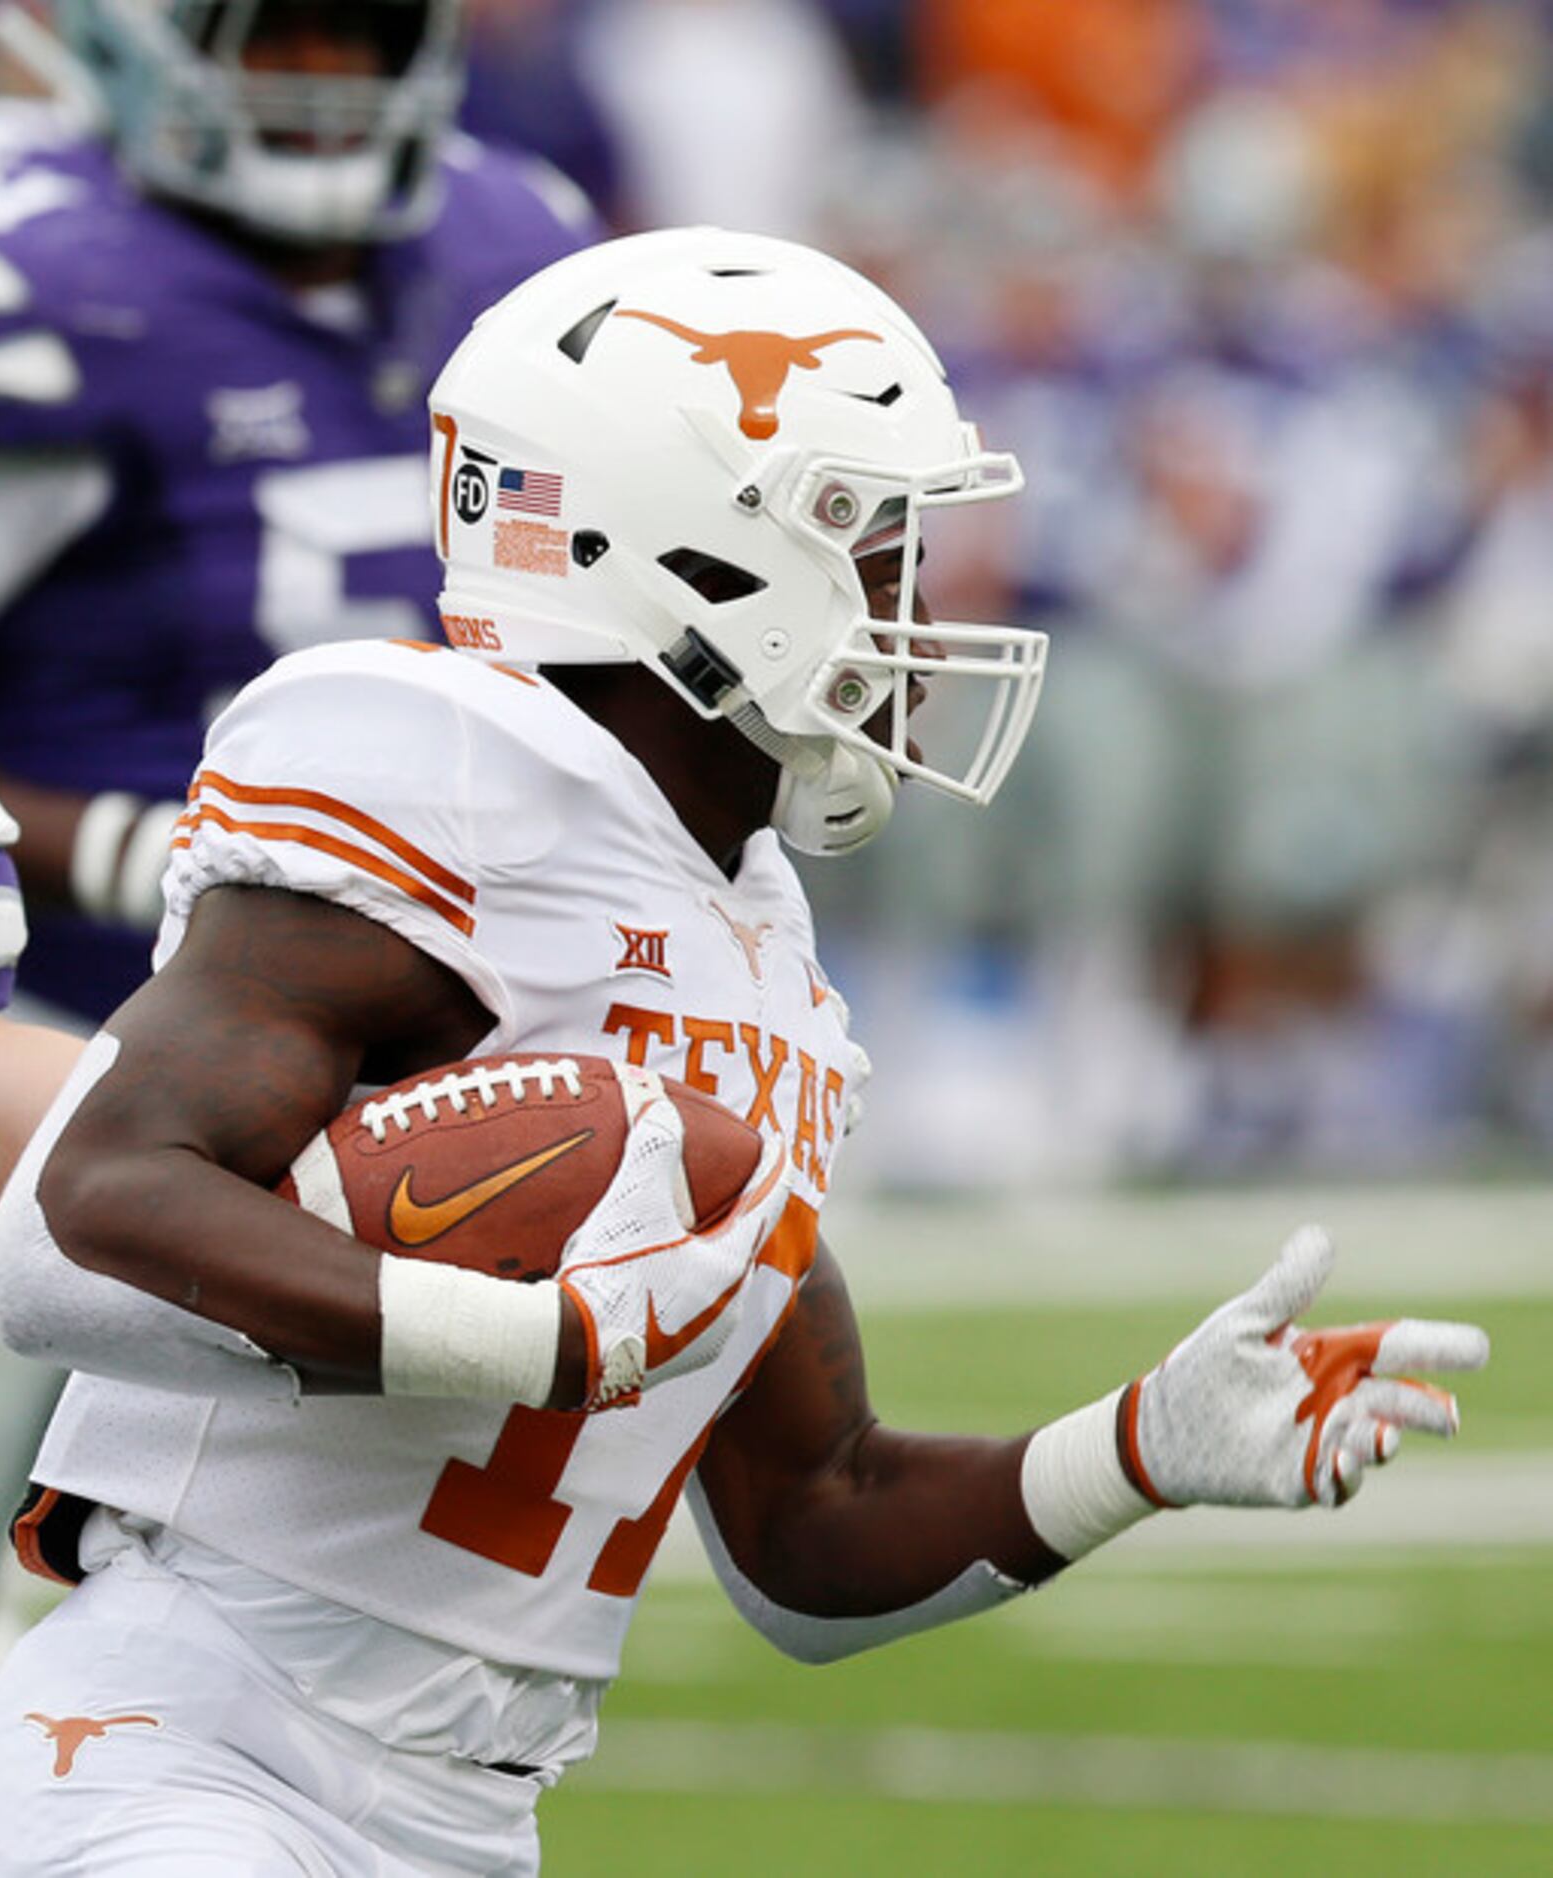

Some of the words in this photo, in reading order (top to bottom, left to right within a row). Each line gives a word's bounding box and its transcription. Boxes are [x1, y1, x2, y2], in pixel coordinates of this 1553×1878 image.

[457, 474, 486, 514] FD
[613, 922, 672, 978] XII
[601, 1002, 844, 1192] TEXAS
